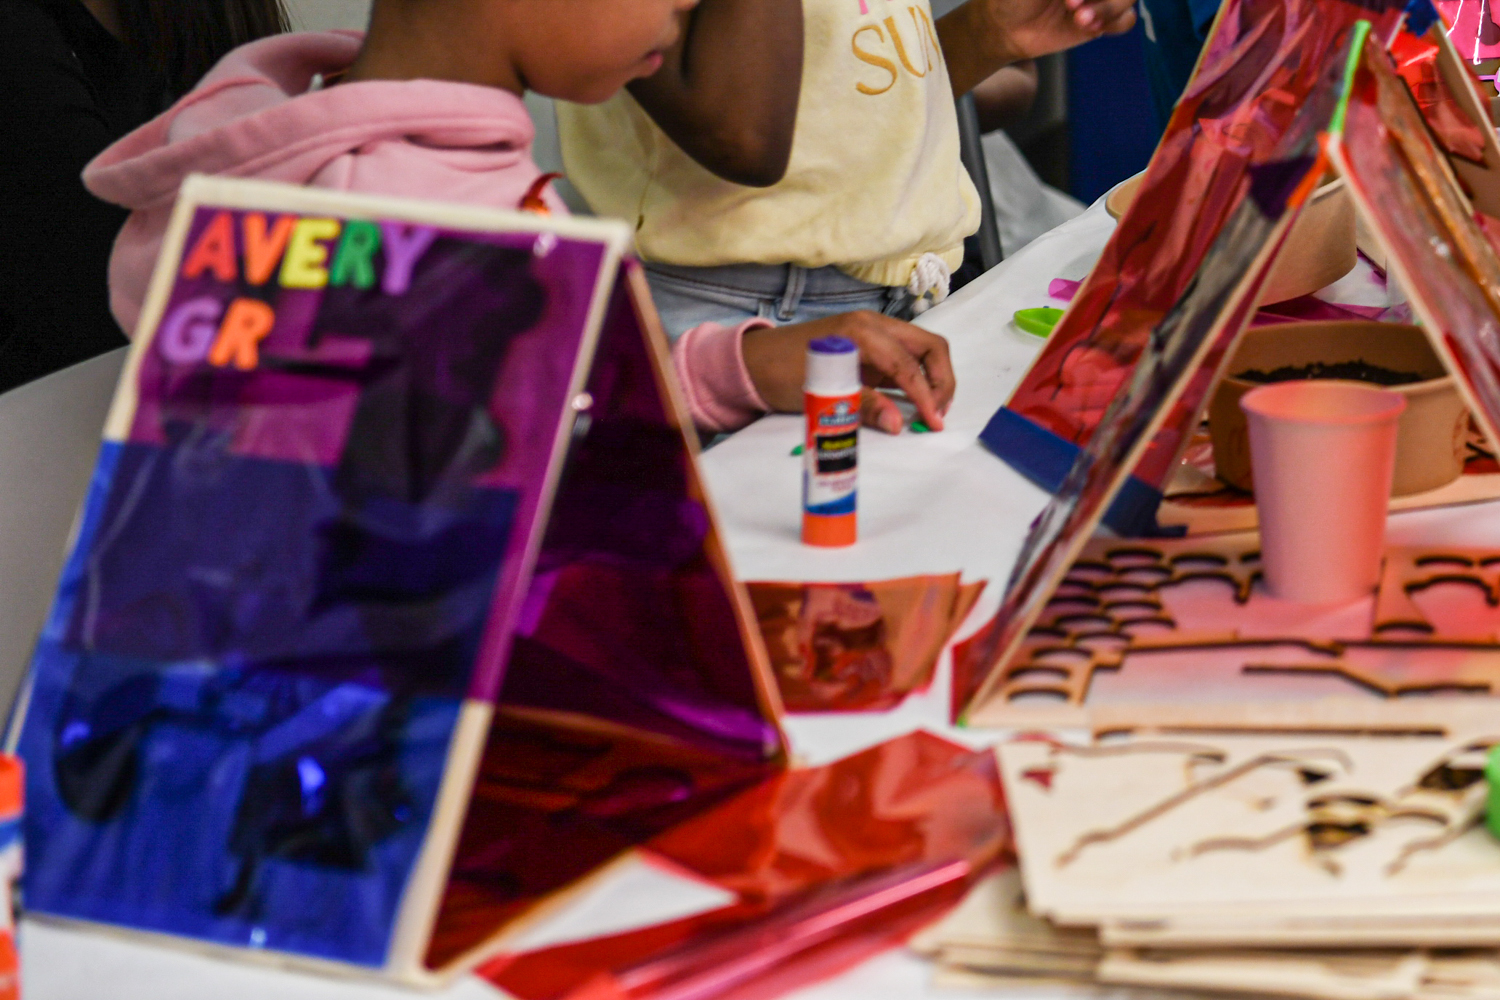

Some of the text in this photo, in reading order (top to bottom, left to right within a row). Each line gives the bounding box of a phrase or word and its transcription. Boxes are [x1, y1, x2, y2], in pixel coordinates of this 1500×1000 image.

[852, 3, 941, 96] SUN
[183, 212, 437, 295] AVERY
[160, 297, 275, 370] GR
